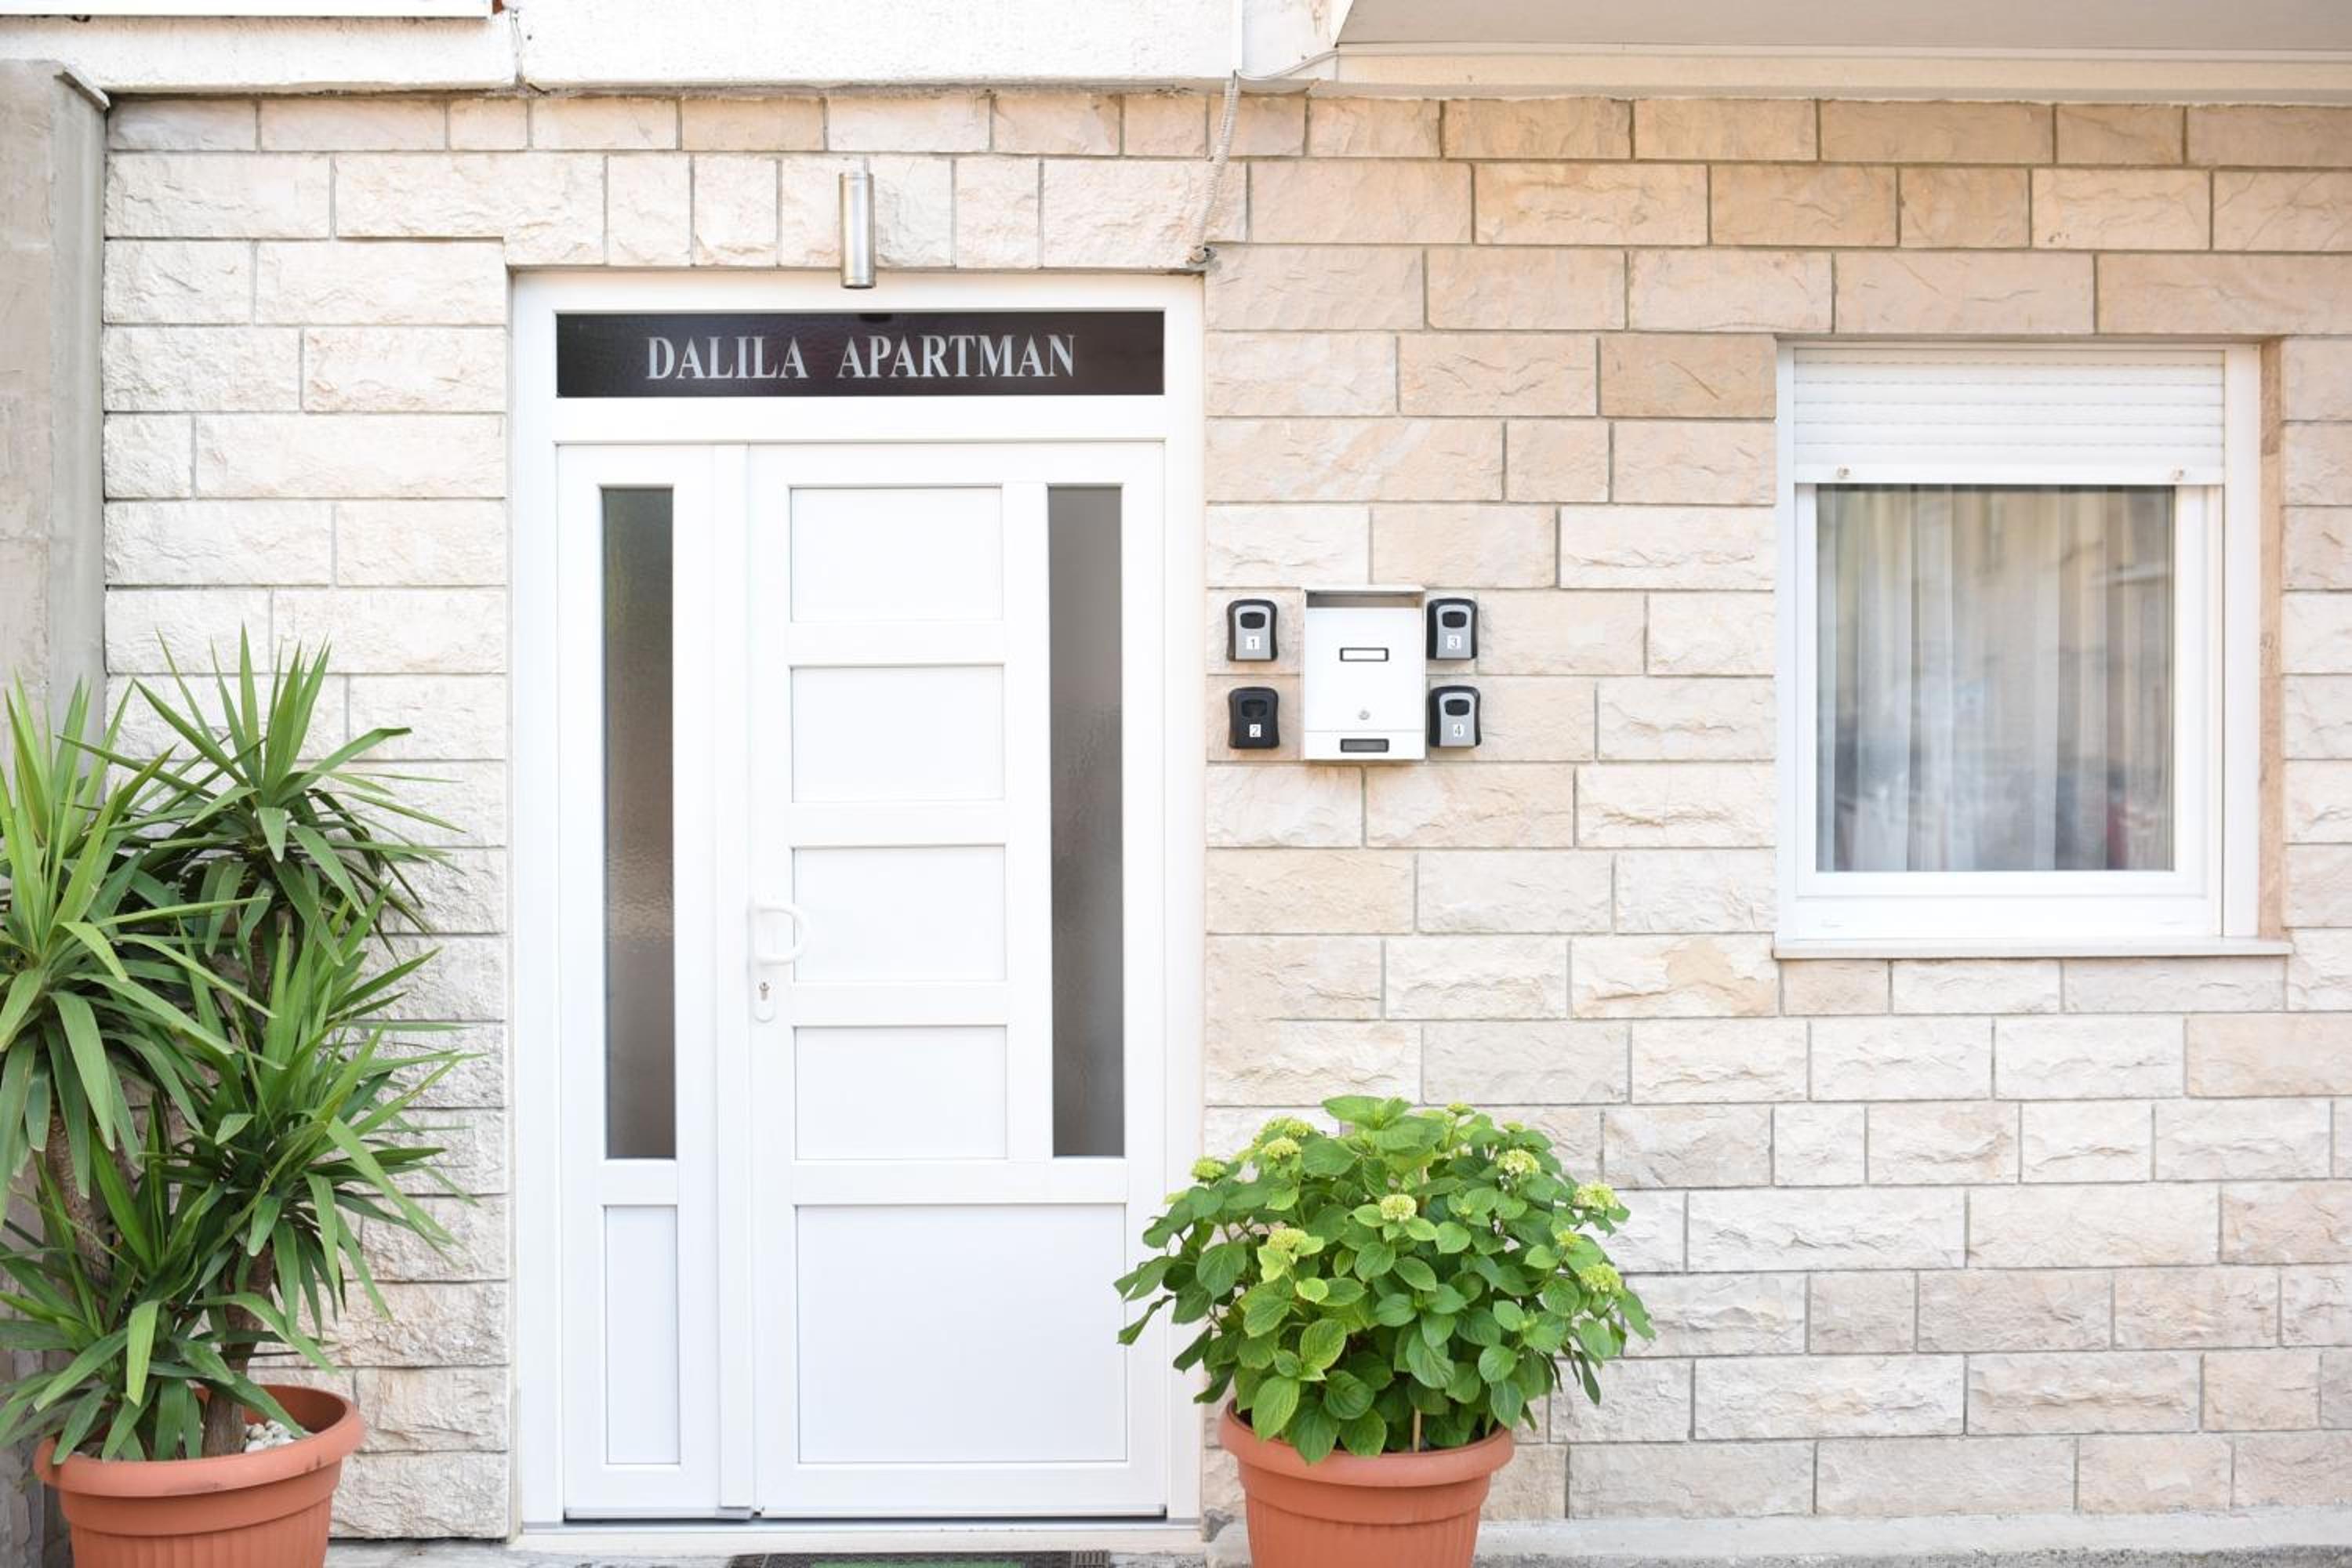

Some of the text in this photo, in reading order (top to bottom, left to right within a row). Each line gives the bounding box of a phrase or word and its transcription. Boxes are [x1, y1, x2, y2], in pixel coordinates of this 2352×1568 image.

[645, 335, 1075, 379] DALILA APARTMAN
[1449, 636, 1458, 648] 3
[1250, 724, 1260, 737] 2
[1454, 724, 1462, 736] 4
